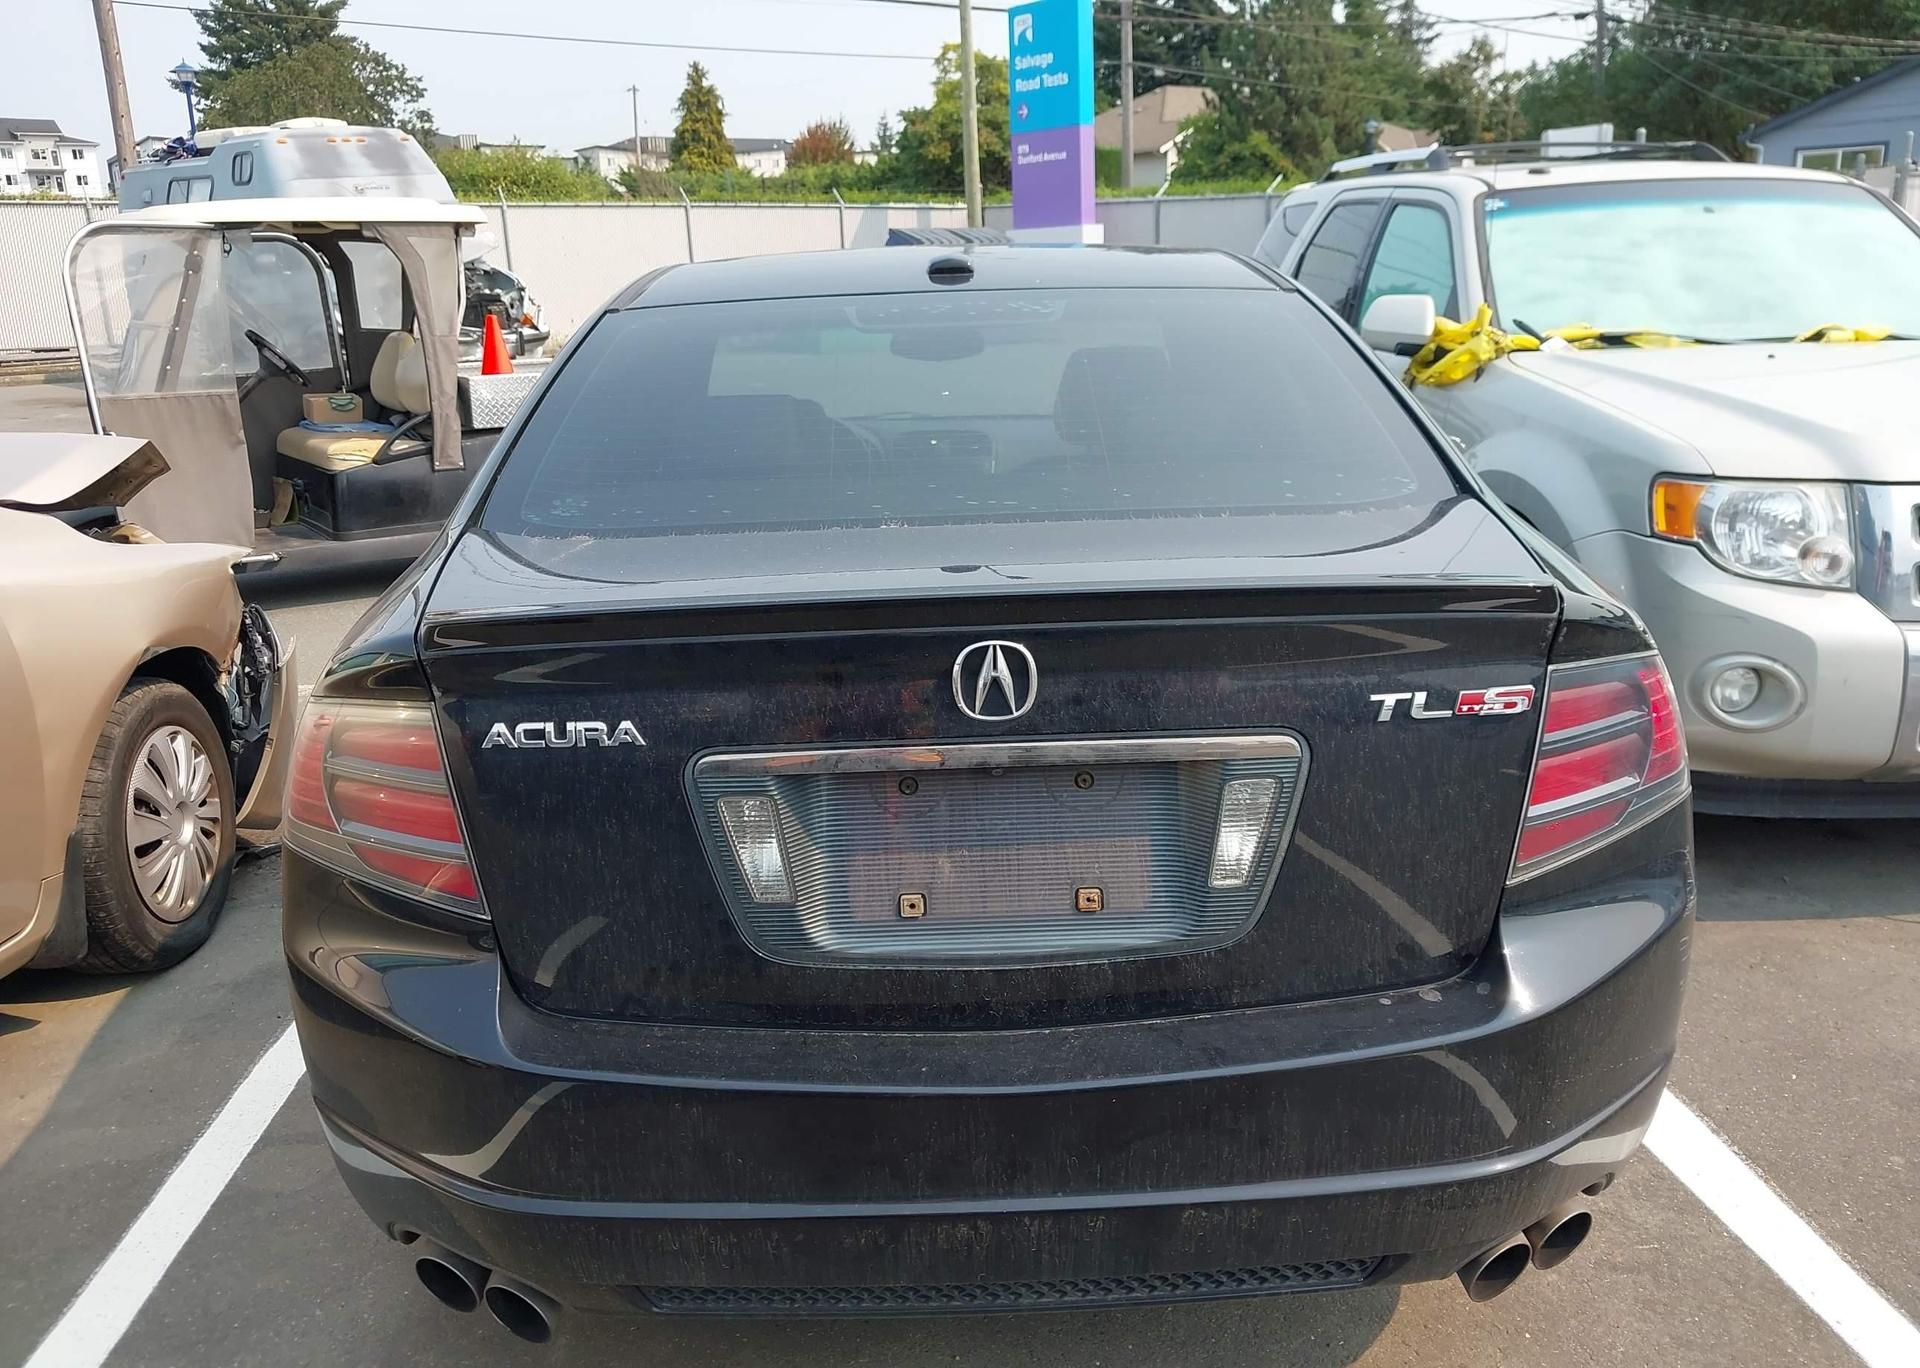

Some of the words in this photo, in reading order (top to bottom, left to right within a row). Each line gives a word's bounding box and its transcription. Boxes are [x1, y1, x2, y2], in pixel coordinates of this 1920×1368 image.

[1014, 51, 1054, 70] Salvage
[1015, 74, 1041, 92] Road
[1042, 72, 1069, 88] Tests
[1043, 151, 1067, 161] Avenue
[1370, 691, 1453, 722] TL
[1460, 704, 1505, 713] TYPE
[481, 720, 647, 748] ACURA
